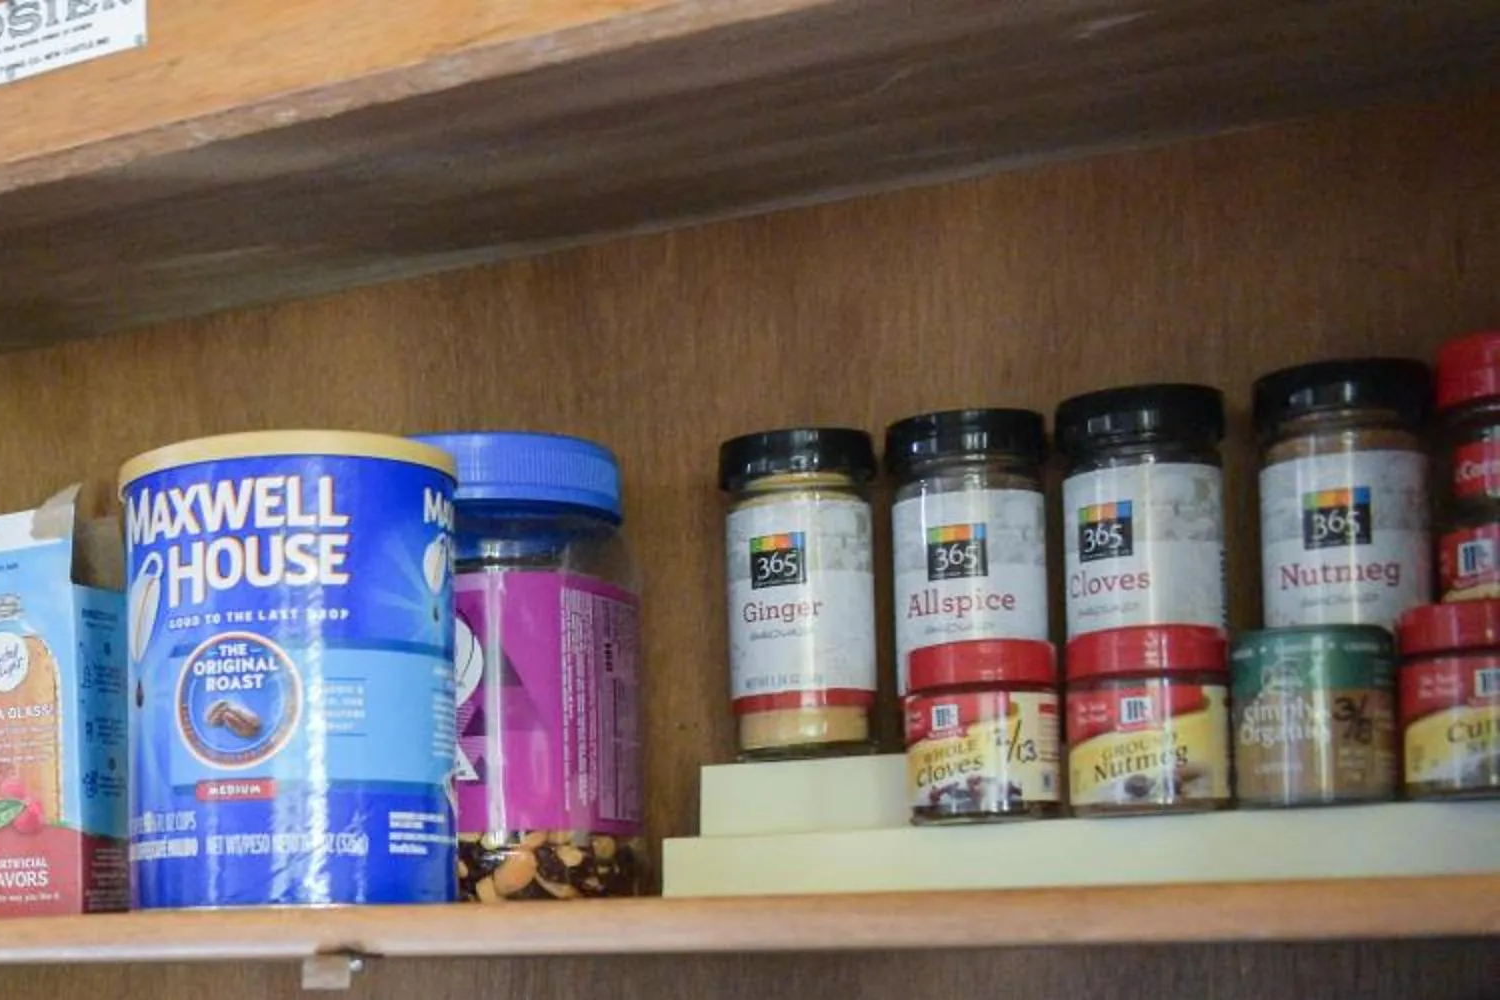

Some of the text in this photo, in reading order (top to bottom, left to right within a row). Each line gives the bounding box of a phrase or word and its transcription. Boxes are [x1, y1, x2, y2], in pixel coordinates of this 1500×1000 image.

[127, 475, 349, 552] MAXWELL
[1312, 509, 1361, 540] 365
[1083, 525, 1123, 553] 365
[168, 533, 349, 609] HOUSE
[757, 552, 798, 582] 365
[935, 541, 977, 572] 365
[1070, 569, 1151, 599] Cloves
[1280, 561, 1400, 591] Nutmeg
[169, 616, 200, 630] GOOD
[205, 613, 221, 625] TO
[227, 611, 252, 623] THE
[258, 609, 298, 621] LAST
[743, 600, 824, 625] Ginger
[908, 589, 1016, 620] Allspice
[219, 643, 249, 656] THE
[194, 656, 278, 676] ORIGINAL
[206, 674, 264, 692] ROAST
[1094, 745, 1188, 784] Nutmeg
[207, 785, 261, 796] MEDIUM
